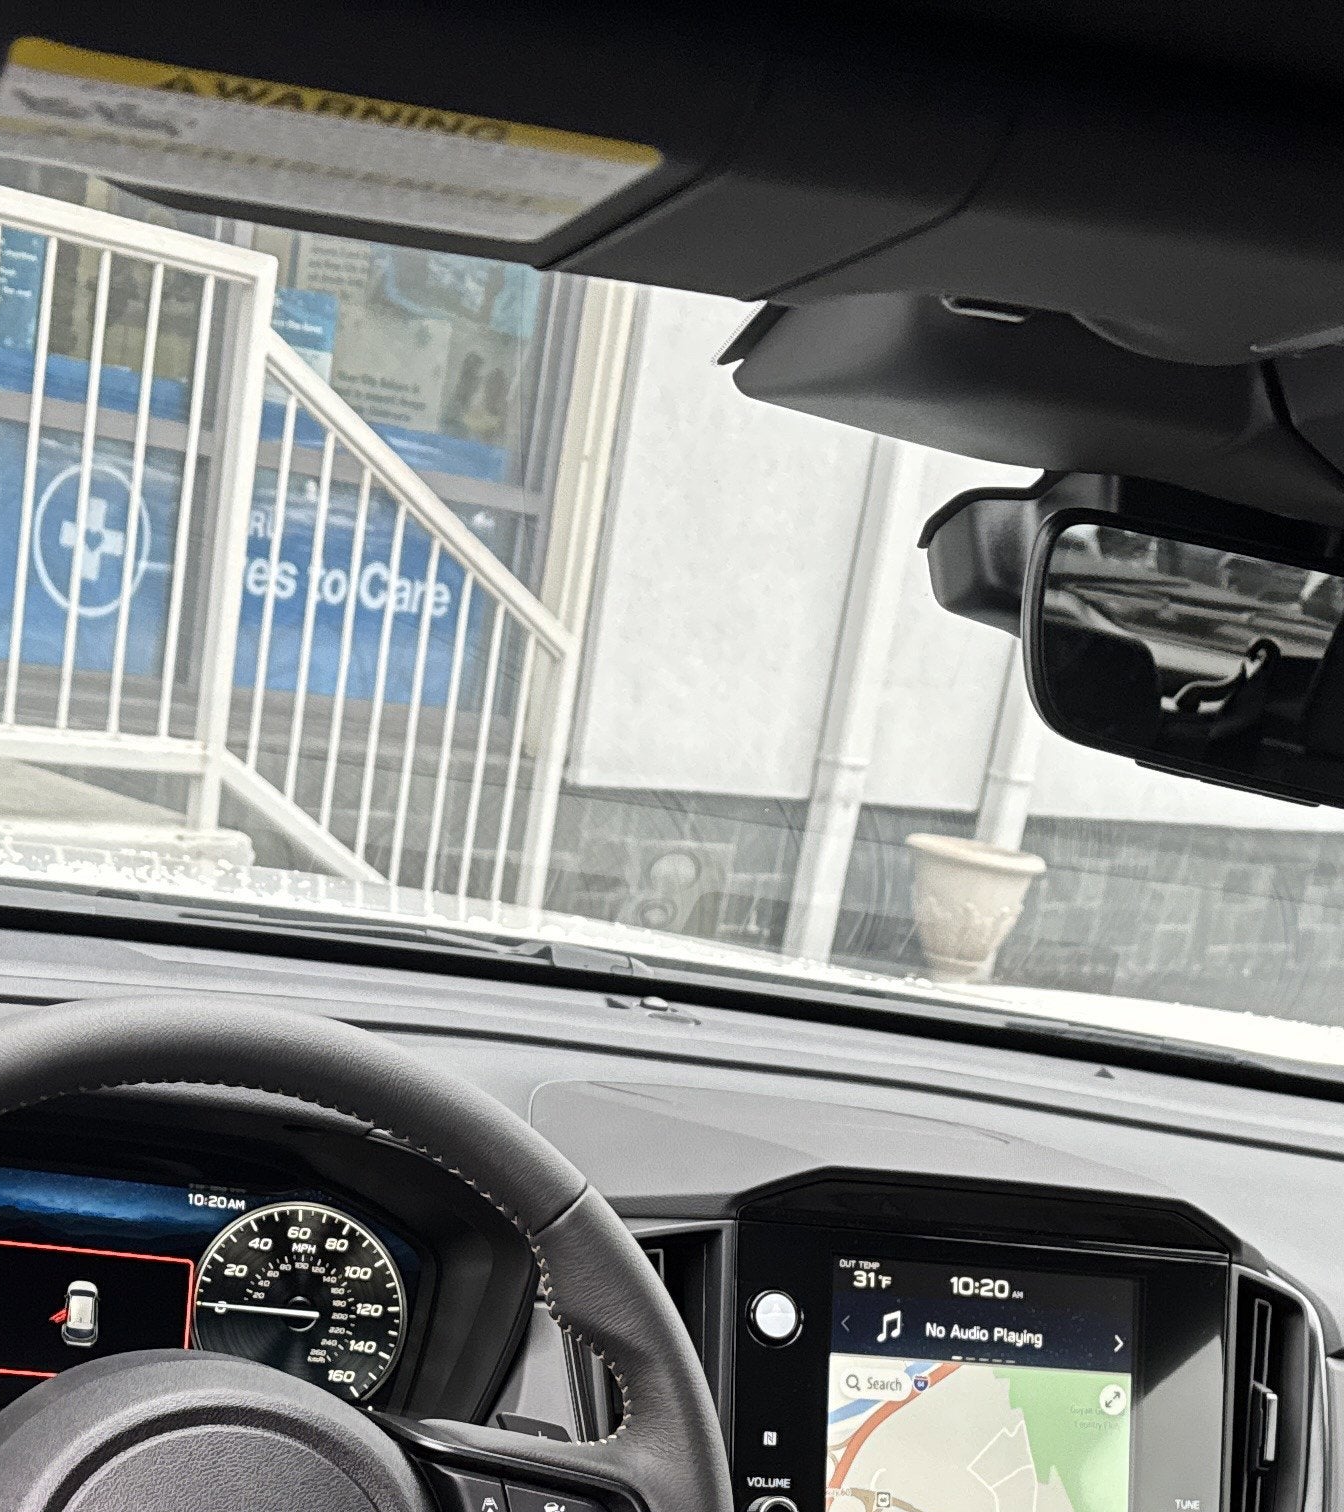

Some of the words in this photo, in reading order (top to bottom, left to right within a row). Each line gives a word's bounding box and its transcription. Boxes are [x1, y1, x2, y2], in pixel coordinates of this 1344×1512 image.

[214, 79, 508, 141] WARNING
[359, 561, 452, 616] Care
[287, 1226, 311, 1239] 60
[248, 1238, 272, 1250] 40
[291, 1243, 316, 1254] MPH
[325, 1238, 349, 1251] 80
[224, 1264, 248, 1277] 20
[839, 1259, 856, 1268] OUT
[858, 1261, 880, 1270] TEMP
[344, 1265, 372, 1280] 100
[950, 1276, 1010, 1298] 10:20
[356, 1303, 383, 1317] 120
[925, 1322, 946, 1338] No
[950, 1323, 989, 1341] Audio
[993, 1327, 1043, 1349] Playing
[349, 1339, 376, 1354] 140
[327, 1369, 356, 1383] 160
[867, 1377, 902, 1391] Search
[747, 1476, 791, 1489] VOLUME
[1175, 1499, 1200, 1510] TUNE
